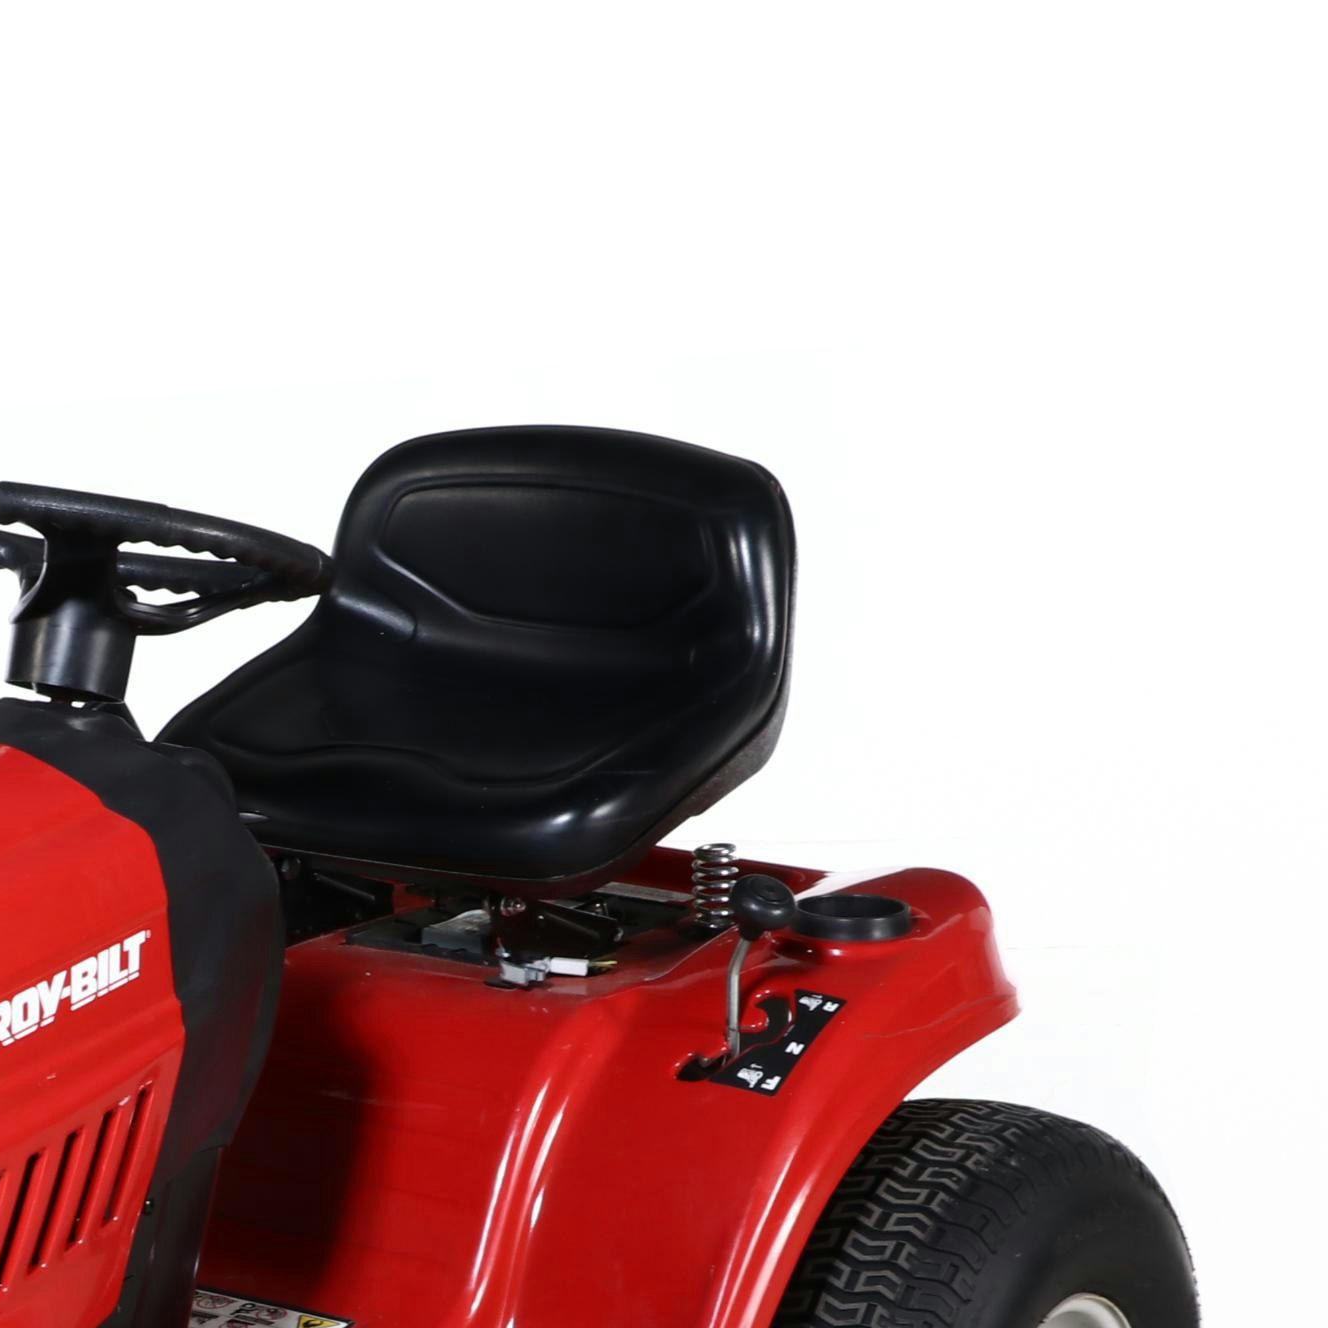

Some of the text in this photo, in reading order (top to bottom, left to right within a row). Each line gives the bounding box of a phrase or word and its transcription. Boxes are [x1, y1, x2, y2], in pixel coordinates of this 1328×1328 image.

[822, 1001, 839, 1012] R
[785, 1042, 805, 1055] N
[761, 1076, 781, 1090] F
